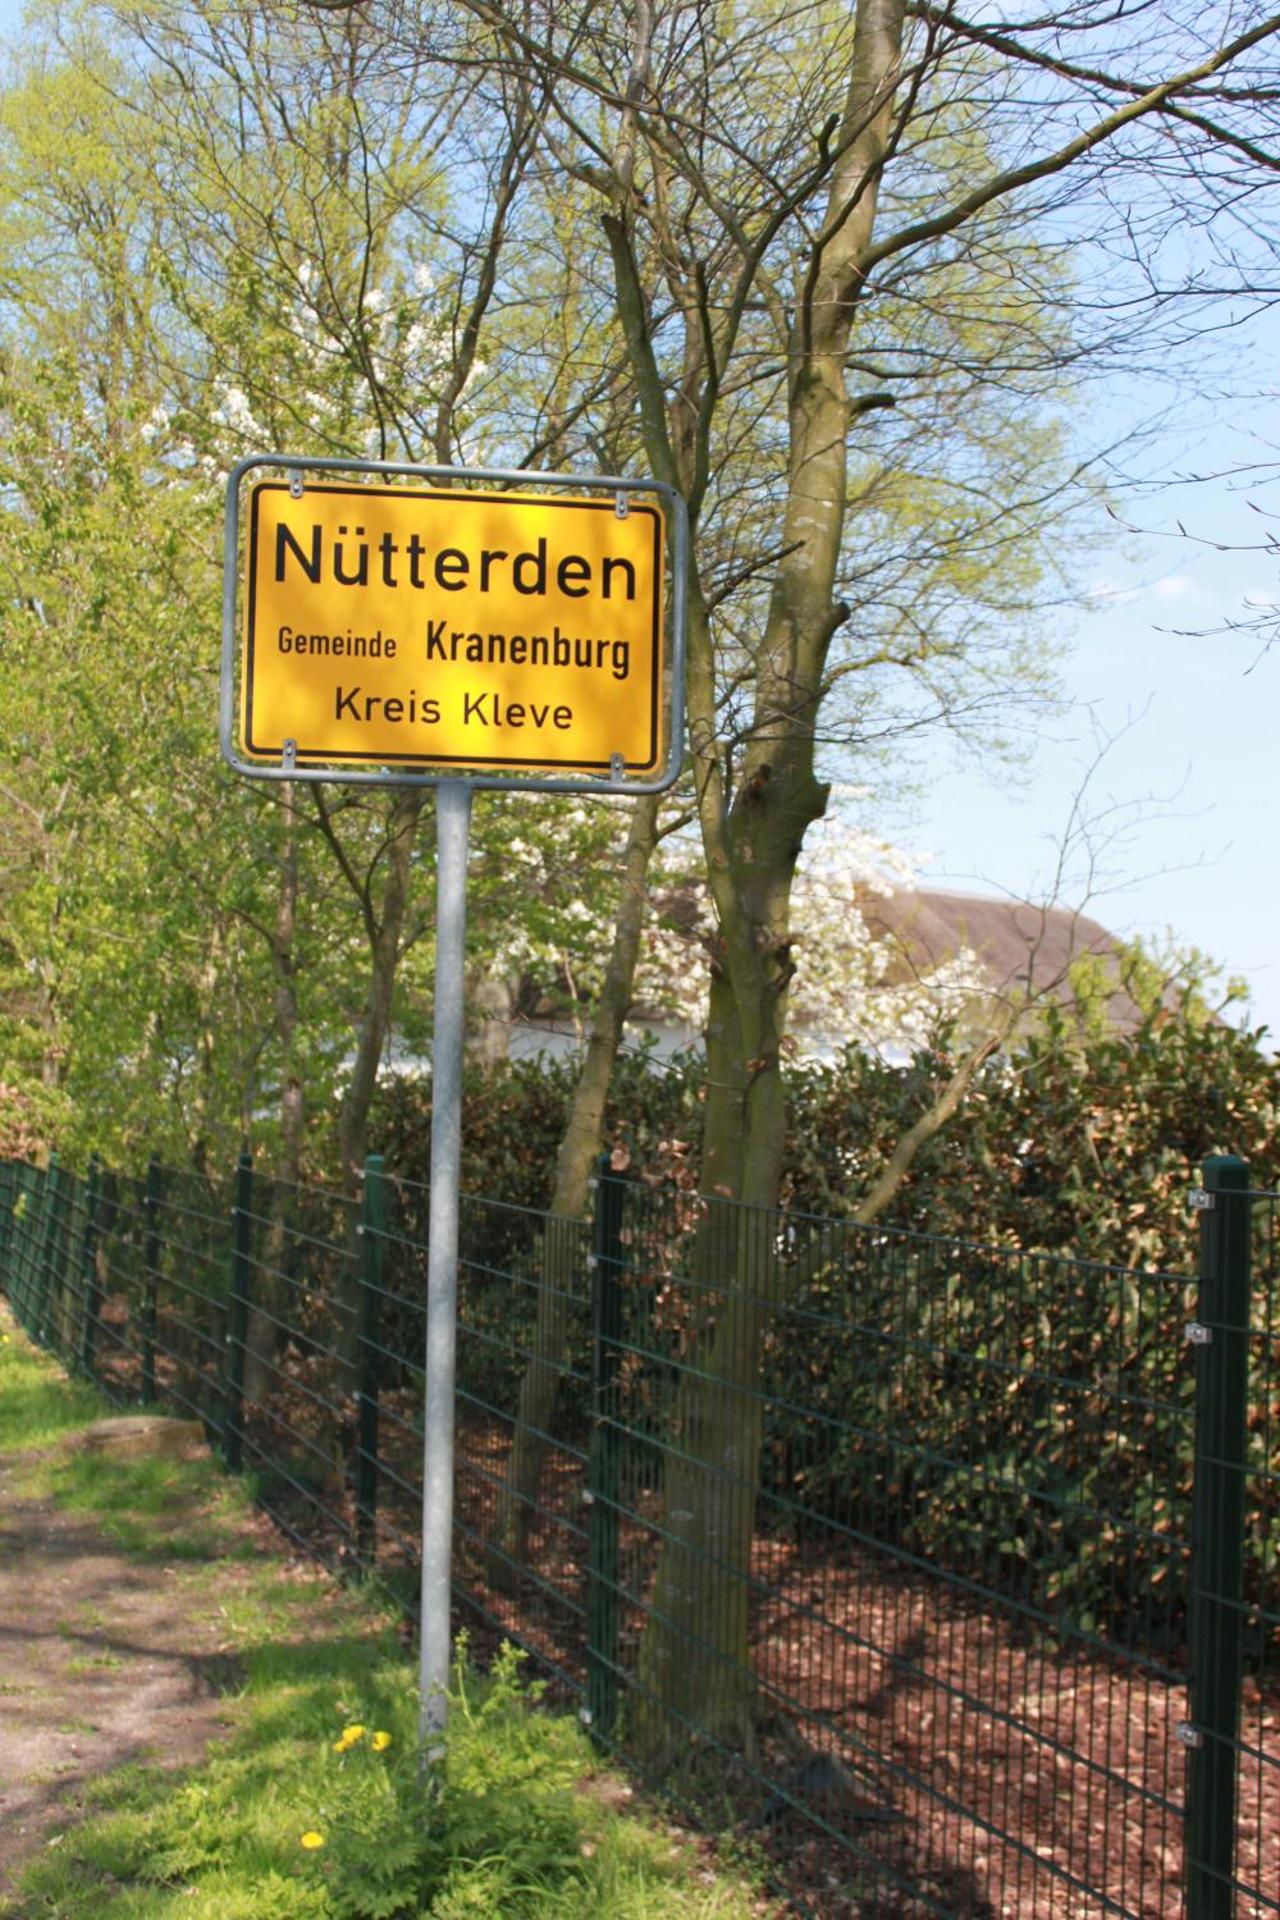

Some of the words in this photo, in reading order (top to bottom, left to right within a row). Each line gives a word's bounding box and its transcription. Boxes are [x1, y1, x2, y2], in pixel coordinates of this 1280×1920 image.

[275, 523, 636, 600] Nütterden
[278, 627, 397, 658] Gemeinde
[426, 621, 630, 680] Kranenburg
[335, 687, 440, 724] Kreis
[464, 693, 573, 729] Kleve
